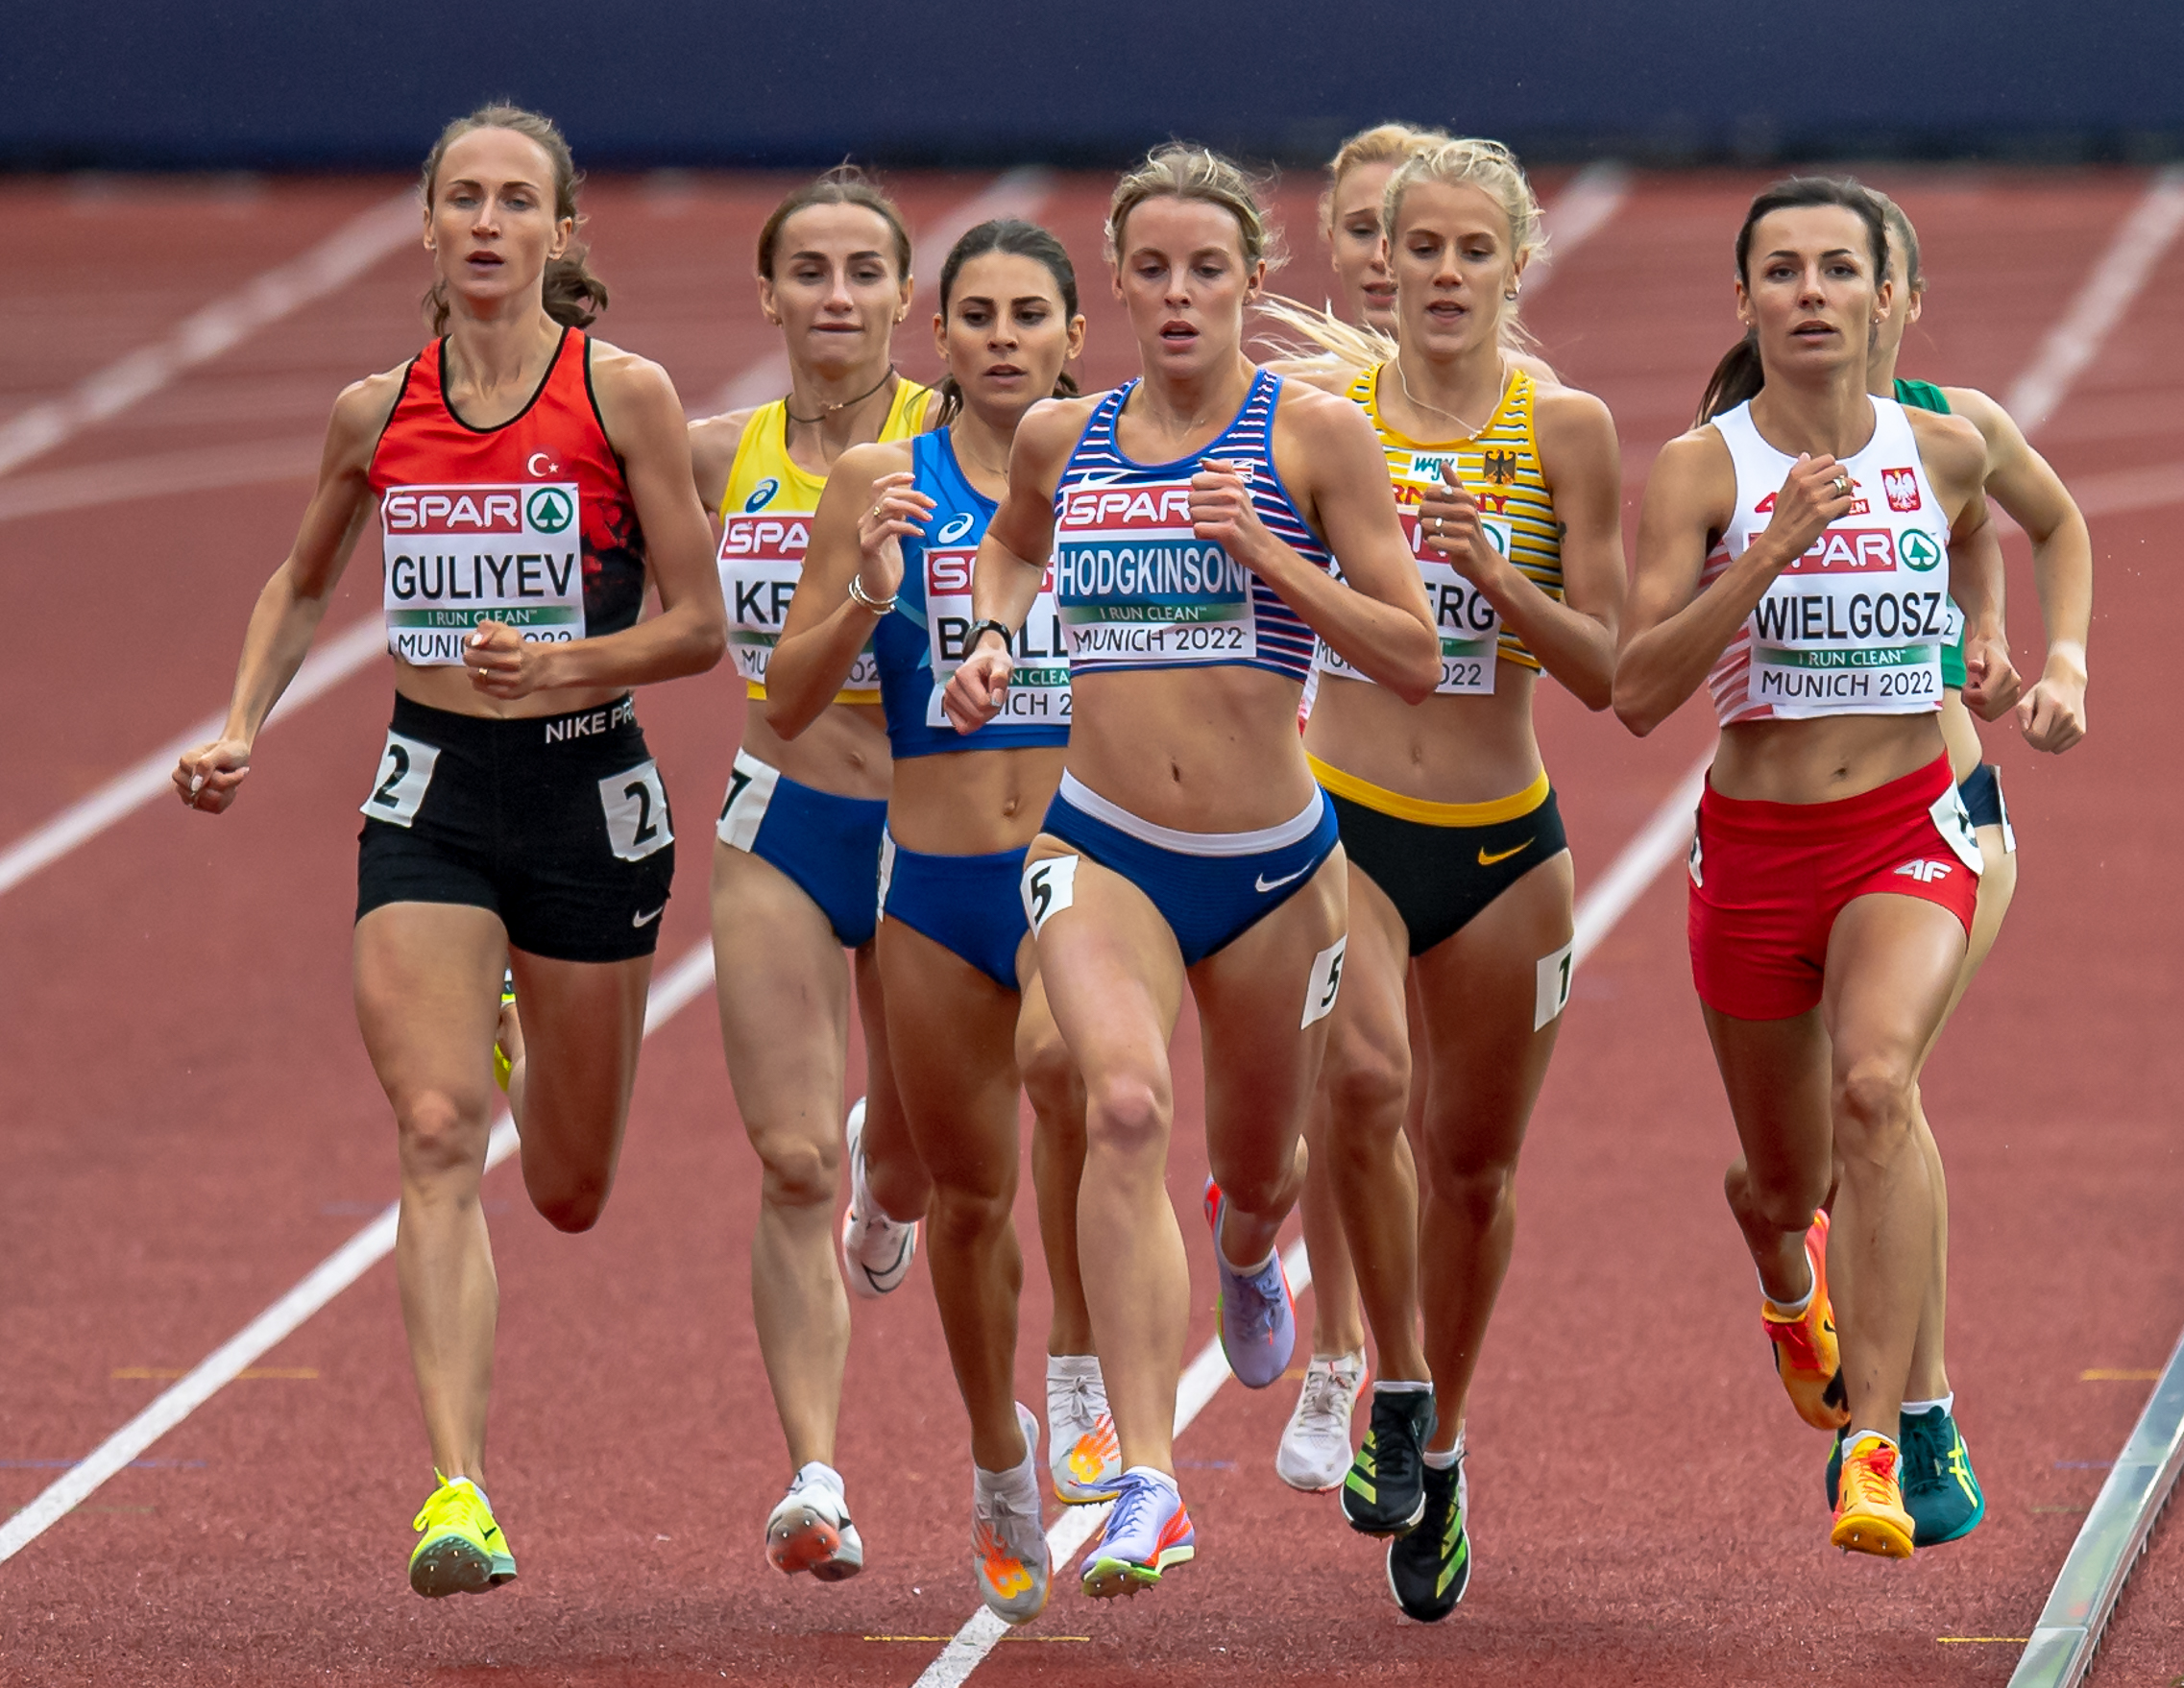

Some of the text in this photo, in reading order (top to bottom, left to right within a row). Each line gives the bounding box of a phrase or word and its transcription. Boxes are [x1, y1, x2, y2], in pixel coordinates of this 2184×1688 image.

[388, 494, 519, 529] SPAR
[1064, 490, 1191, 524] SPAR
[726, 522, 811, 554] SPA
[1790, 533, 1893, 568] PAR
[391, 553, 574, 600] GULIYEV
[1058, 546, 1245, 596] HODGKINSON
[427, 612, 432, 625] I
[436, 611, 468, 625] RUN
[1110, 608, 1142, 620] RUN
[1755, 591, 1941, 640] WIELGOSZ
[398, 633, 466, 658] MUNI
[1073, 626, 1243, 653] MUNICH 2022
[1808, 652, 1845, 666] RUN
[1029, 670, 1071, 685] CLEA
[1761, 670, 1933, 698] MUNICH 2022
[546, 704, 634, 744] NIKE PR
[373, 744, 410, 808] 2
[623, 781, 658, 847] 2
[1031, 864, 1052, 926] 5
[1321, 950, 1345, 1008] 5
[1558, 950, 1572, 1005] 1
